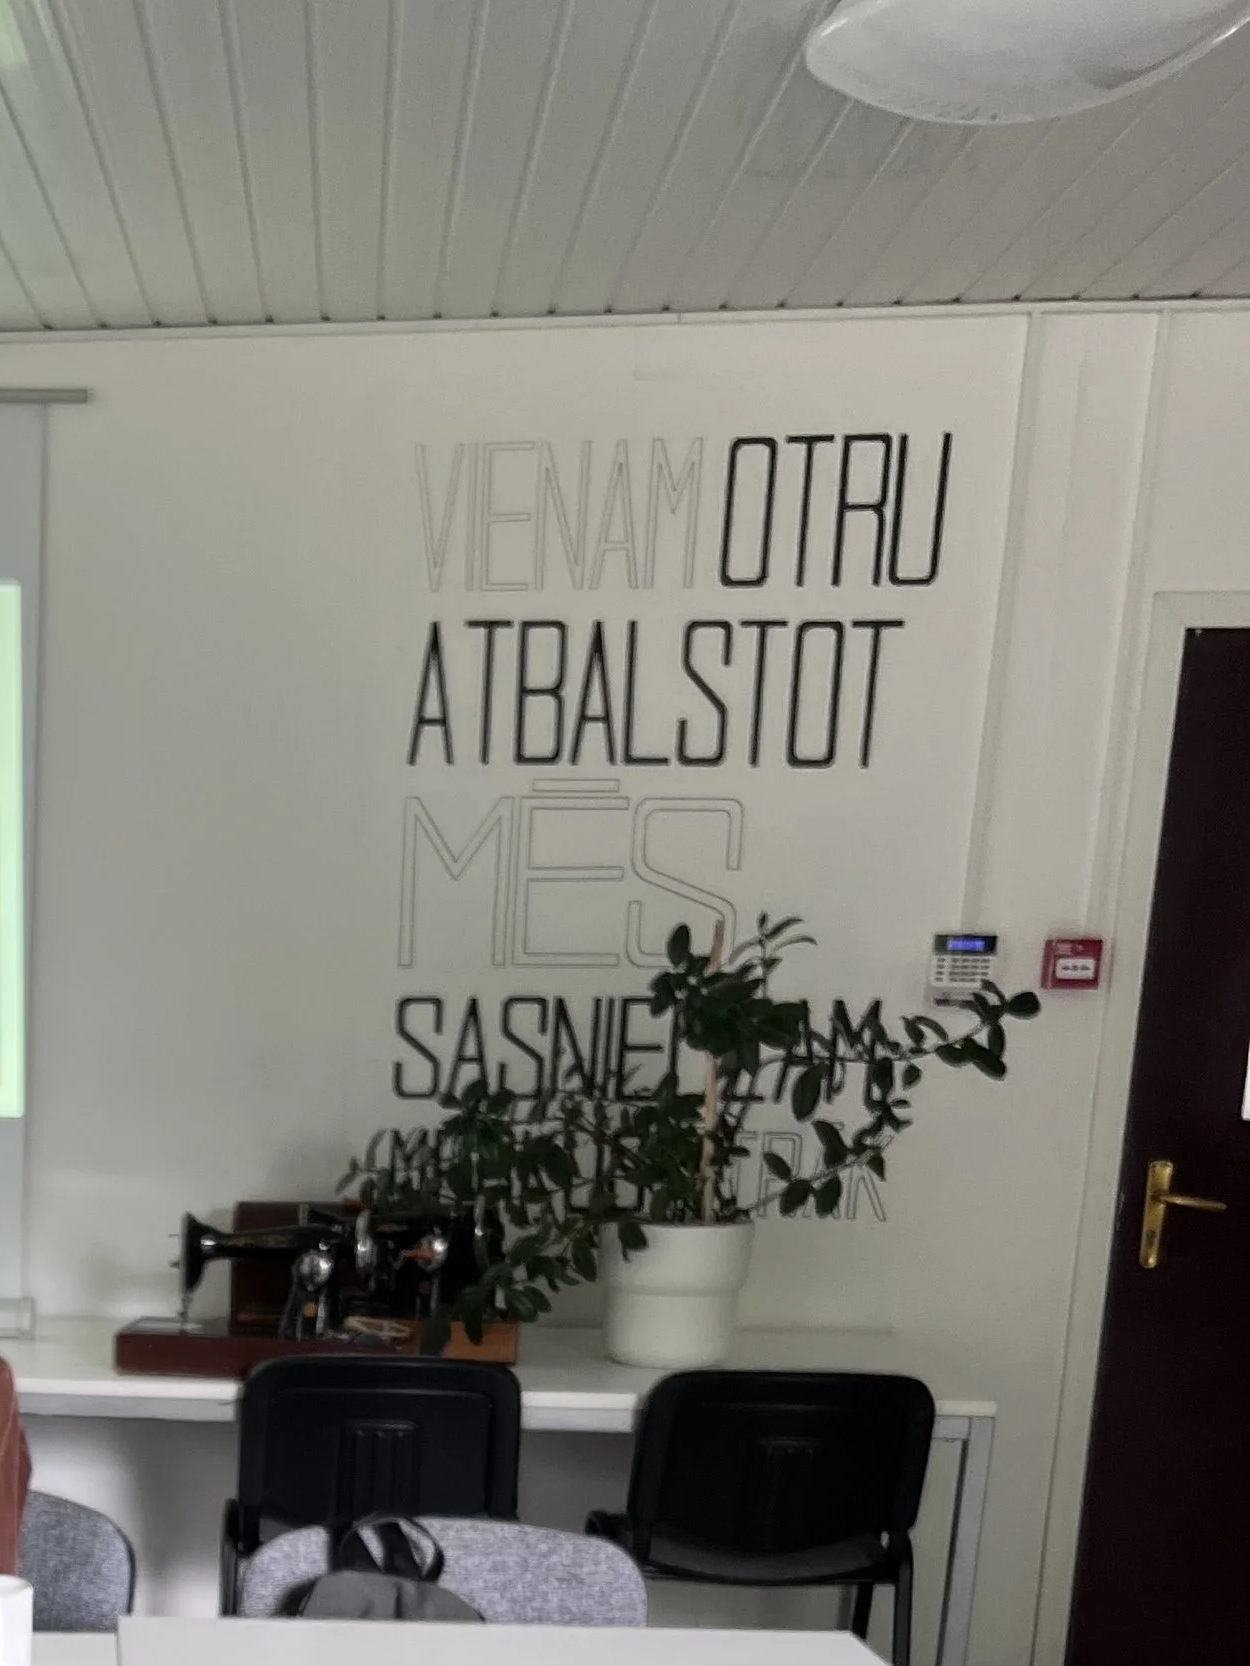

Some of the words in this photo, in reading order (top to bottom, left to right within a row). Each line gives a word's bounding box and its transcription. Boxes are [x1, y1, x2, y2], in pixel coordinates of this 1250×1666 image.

[415, 437, 703, 592] VIENAM
[719, 431, 953, 588] OTRU
[406, 618, 905, 768] ATBALSTOT
[396, 778, 744, 969] MĒS
